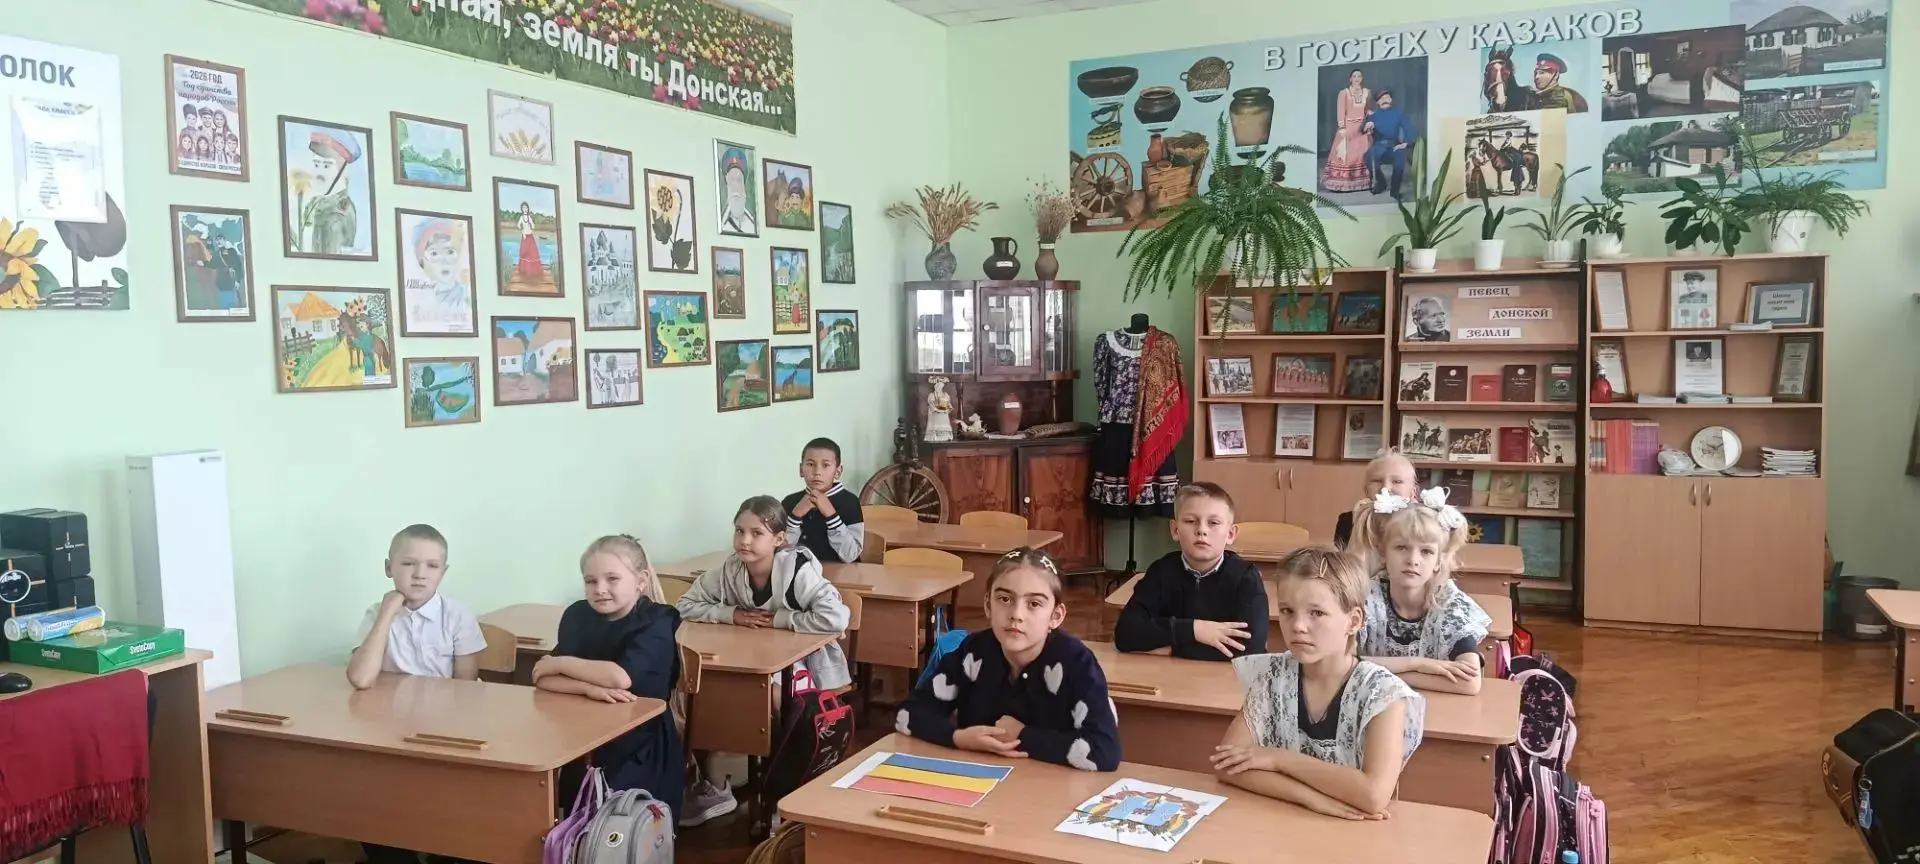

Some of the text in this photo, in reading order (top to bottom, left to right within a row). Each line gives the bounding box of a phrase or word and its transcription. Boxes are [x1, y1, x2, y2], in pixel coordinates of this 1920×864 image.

[1264, 7, 1643, 71] В ГОСТЯХ У КАЗАКОВ
[523, 12, 618, 70] земля
[626, 52, 663, 85] ты
[668, 58, 783, 115] Донская...
[208, 73, 223, 84] ГОД
[1468, 287, 1510, 297] ПЕВЕЦ
[1492, 308, 1549, 319] ДОНСКОЙ
[1466, 328, 1511, 338] ЗЕМЛИ
